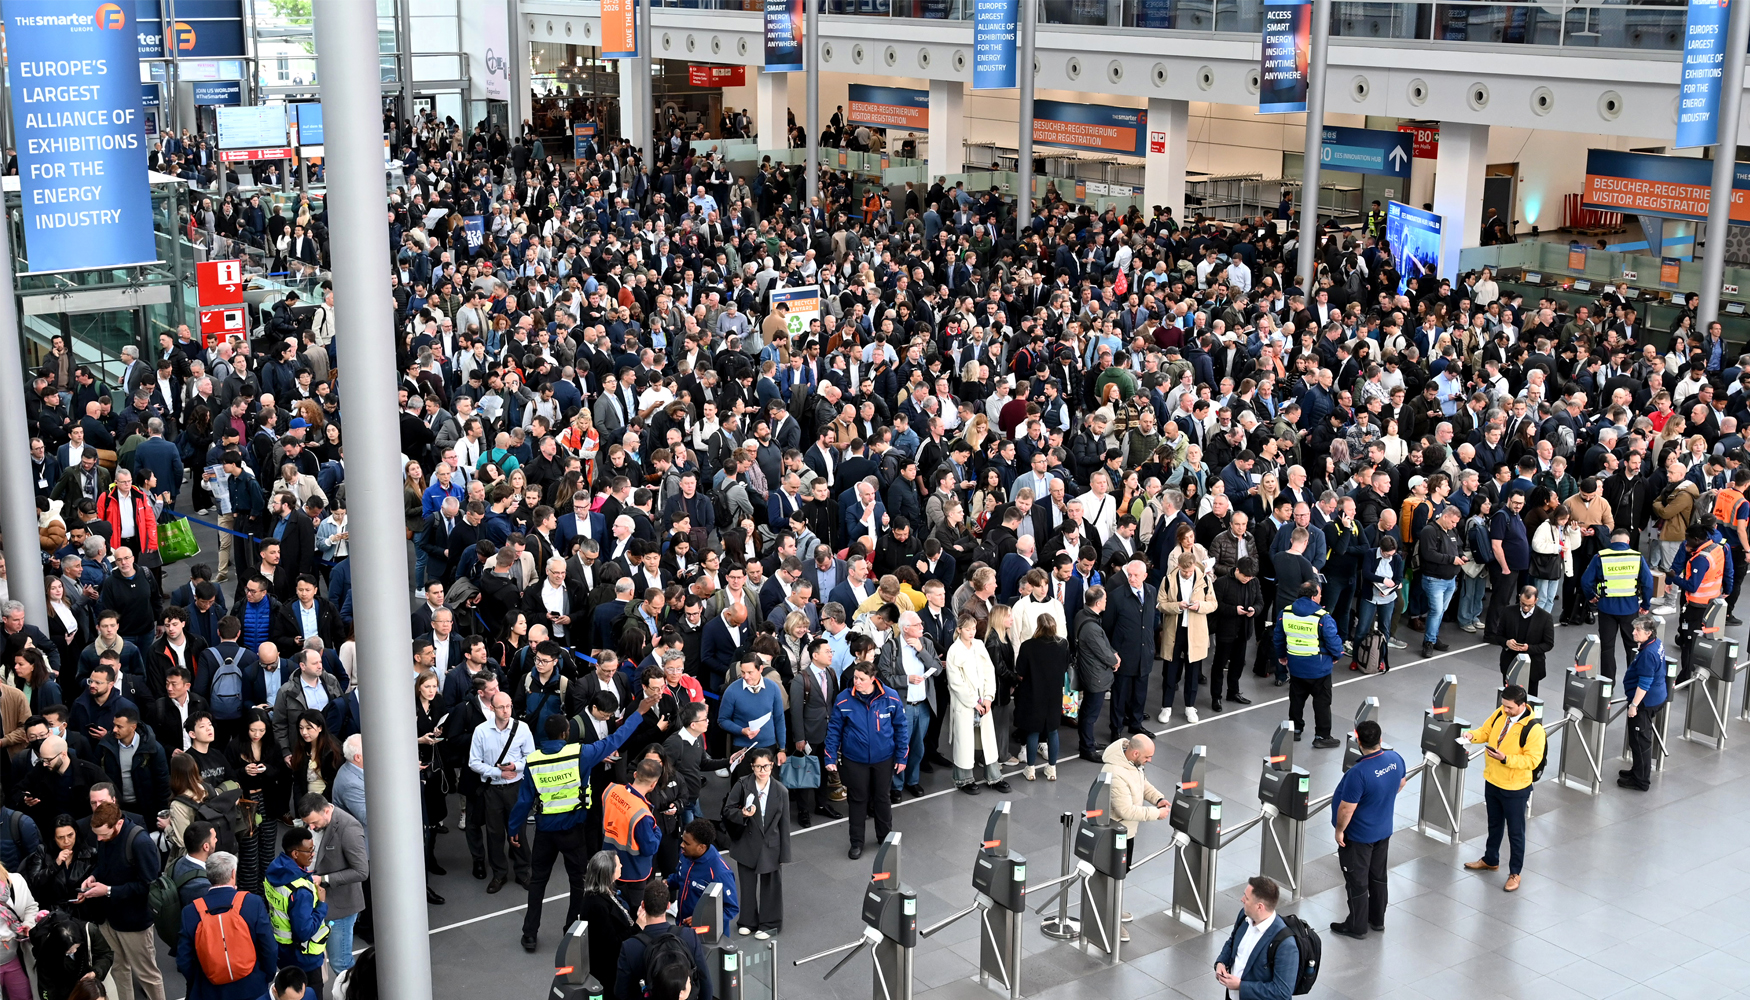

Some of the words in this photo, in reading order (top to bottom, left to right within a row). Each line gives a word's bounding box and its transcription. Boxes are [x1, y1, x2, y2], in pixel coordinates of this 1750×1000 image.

[1267, 11, 1291, 19] ACCESS
[1267, 23, 1290, 31] SMART
[1689, 24, 1719, 34] EUROPE'S
[977, 33, 1015, 41] EXHIBITIONS
[1266, 36, 1293, 44] ENERGY
[1688, 39, 1714, 49] LARGEST
[1265, 47, 1295, 56] INSIGHTS
[1265, 59, 1296, 68] ANYTIME,
[1686, 54, 1714, 64] ALLIANCE
[1715, 53, 1724, 63] OF
[20, 59, 107, 77] EUROPE'S
[977, 64, 1007, 72] INDUSTRY
[1685, 68, 1722, 79] EXHIBITIONS
[1264, 71, 1301, 80] ANYWHERE
[23, 85, 100, 103] LARGEST
[1684, 84, 1696, 94] FOR
[1697, 83, 1709, 92] THE
[1682, 98, 1706, 108] ENERGY
[852, 103, 919, 116] BESUCHER-REGISTRIERUNG
[25, 110, 109, 129] ALLIANCE
[112, 109, 135, 124] OF
[852, 112, 871, 120] VISITOR
[871, 113, 907, 124] REGISTRATION
[1681, 112, 1710, 123] INDUSTRY
[1033, 121, 1117, 137] BESUCHER-REGISTRIERUNG
[1033, 130, 1057, 140] VISITOR
[1058, 133, 1102, 146] REGISTRATION
[28, 134, 138, 154] EXHIBITIONS
[30, 163, 66, 179] FOR
[69, 160, 105, 177] THE
[33, 185, 102, 205] ENERGY
[1594, 178, 1744, 203] BESUCHER-REGISTRIENG
[1592, 191, 1633, 205] VISITOR
[35, 208, 122, 230] INDUSTRY
[1288, 623, 1312, 632] SECURITY
[1374, 762, 1397, 778] Security
[539, 772, 572, 783] SECURITY
[610, 791, 631, 811] SECURITY
